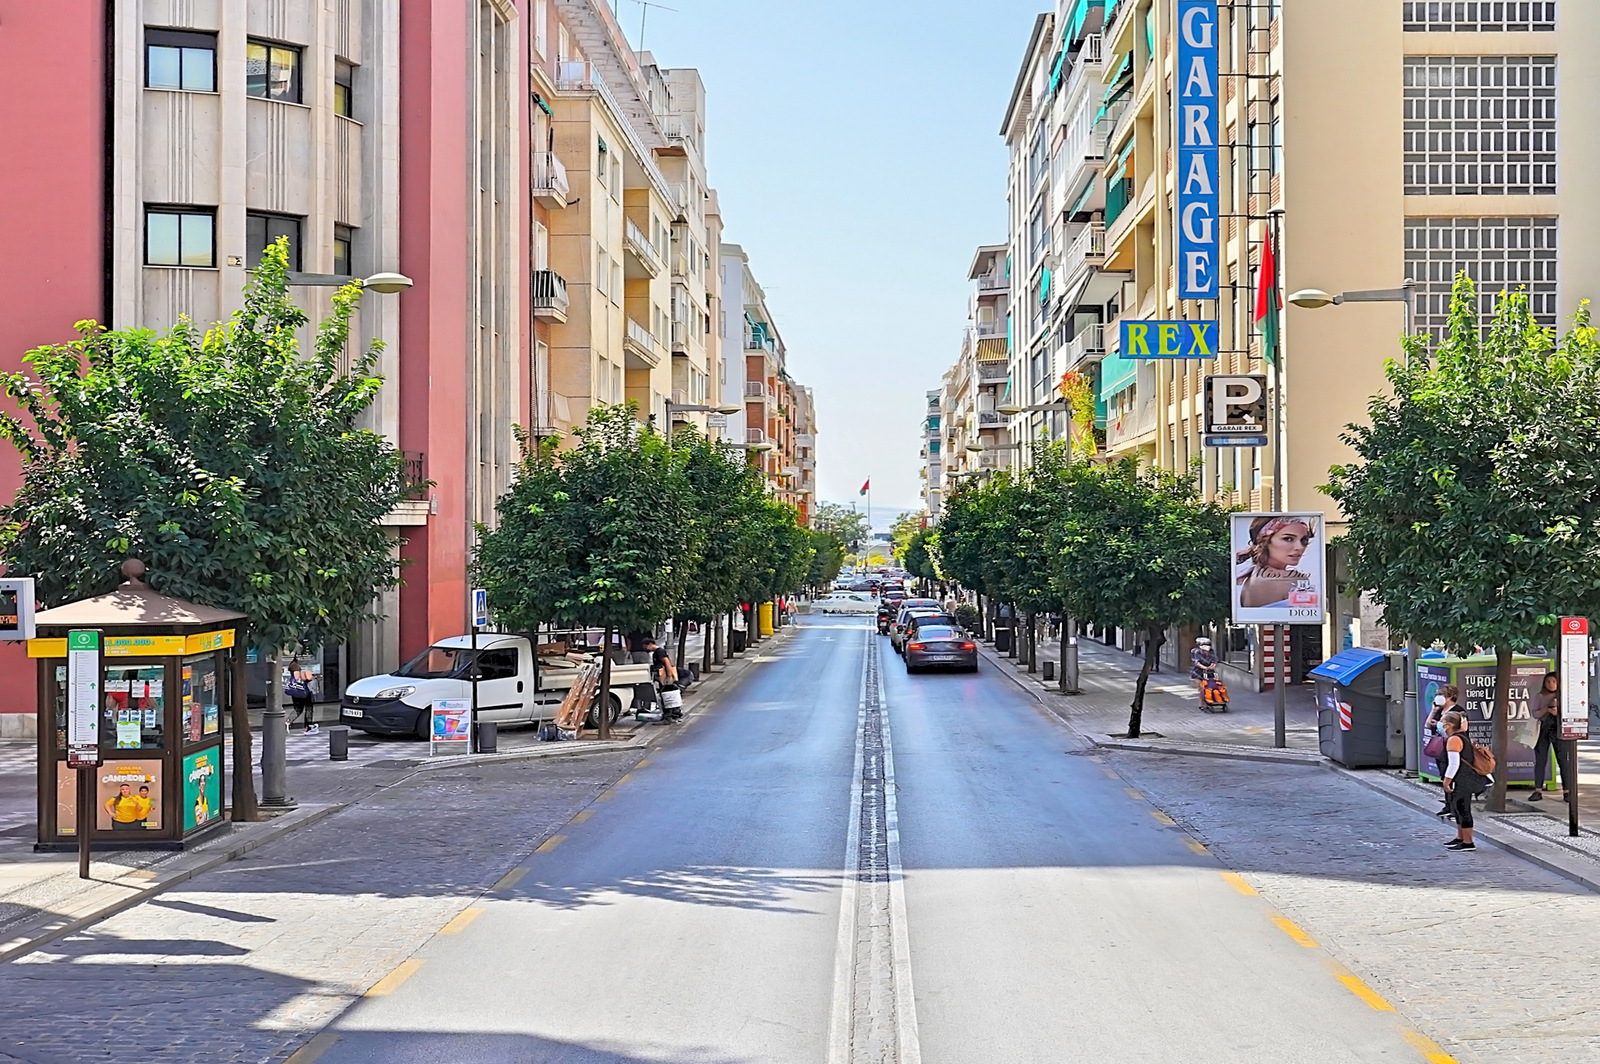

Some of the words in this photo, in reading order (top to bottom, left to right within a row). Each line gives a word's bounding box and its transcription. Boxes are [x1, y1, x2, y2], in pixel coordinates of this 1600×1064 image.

[1182, 5, 1213, 294] GARAGE
[1127, 323, 1211, 356] REX
[1213, 377, 1261, 424] P
[1248, 567, 1280, 578] Miss
[1284, 569, 1311, 578] Dior
[1465, 676, 1476, 685] TU
[1477, 676, 1496, 687] ROP
[1466, 688, 1484, 698] tiene
[1508, 688, 1530, 700] ELA
[1466, 701, 1478, 710] DE
[1480, 701, 1531, 720] VDA
